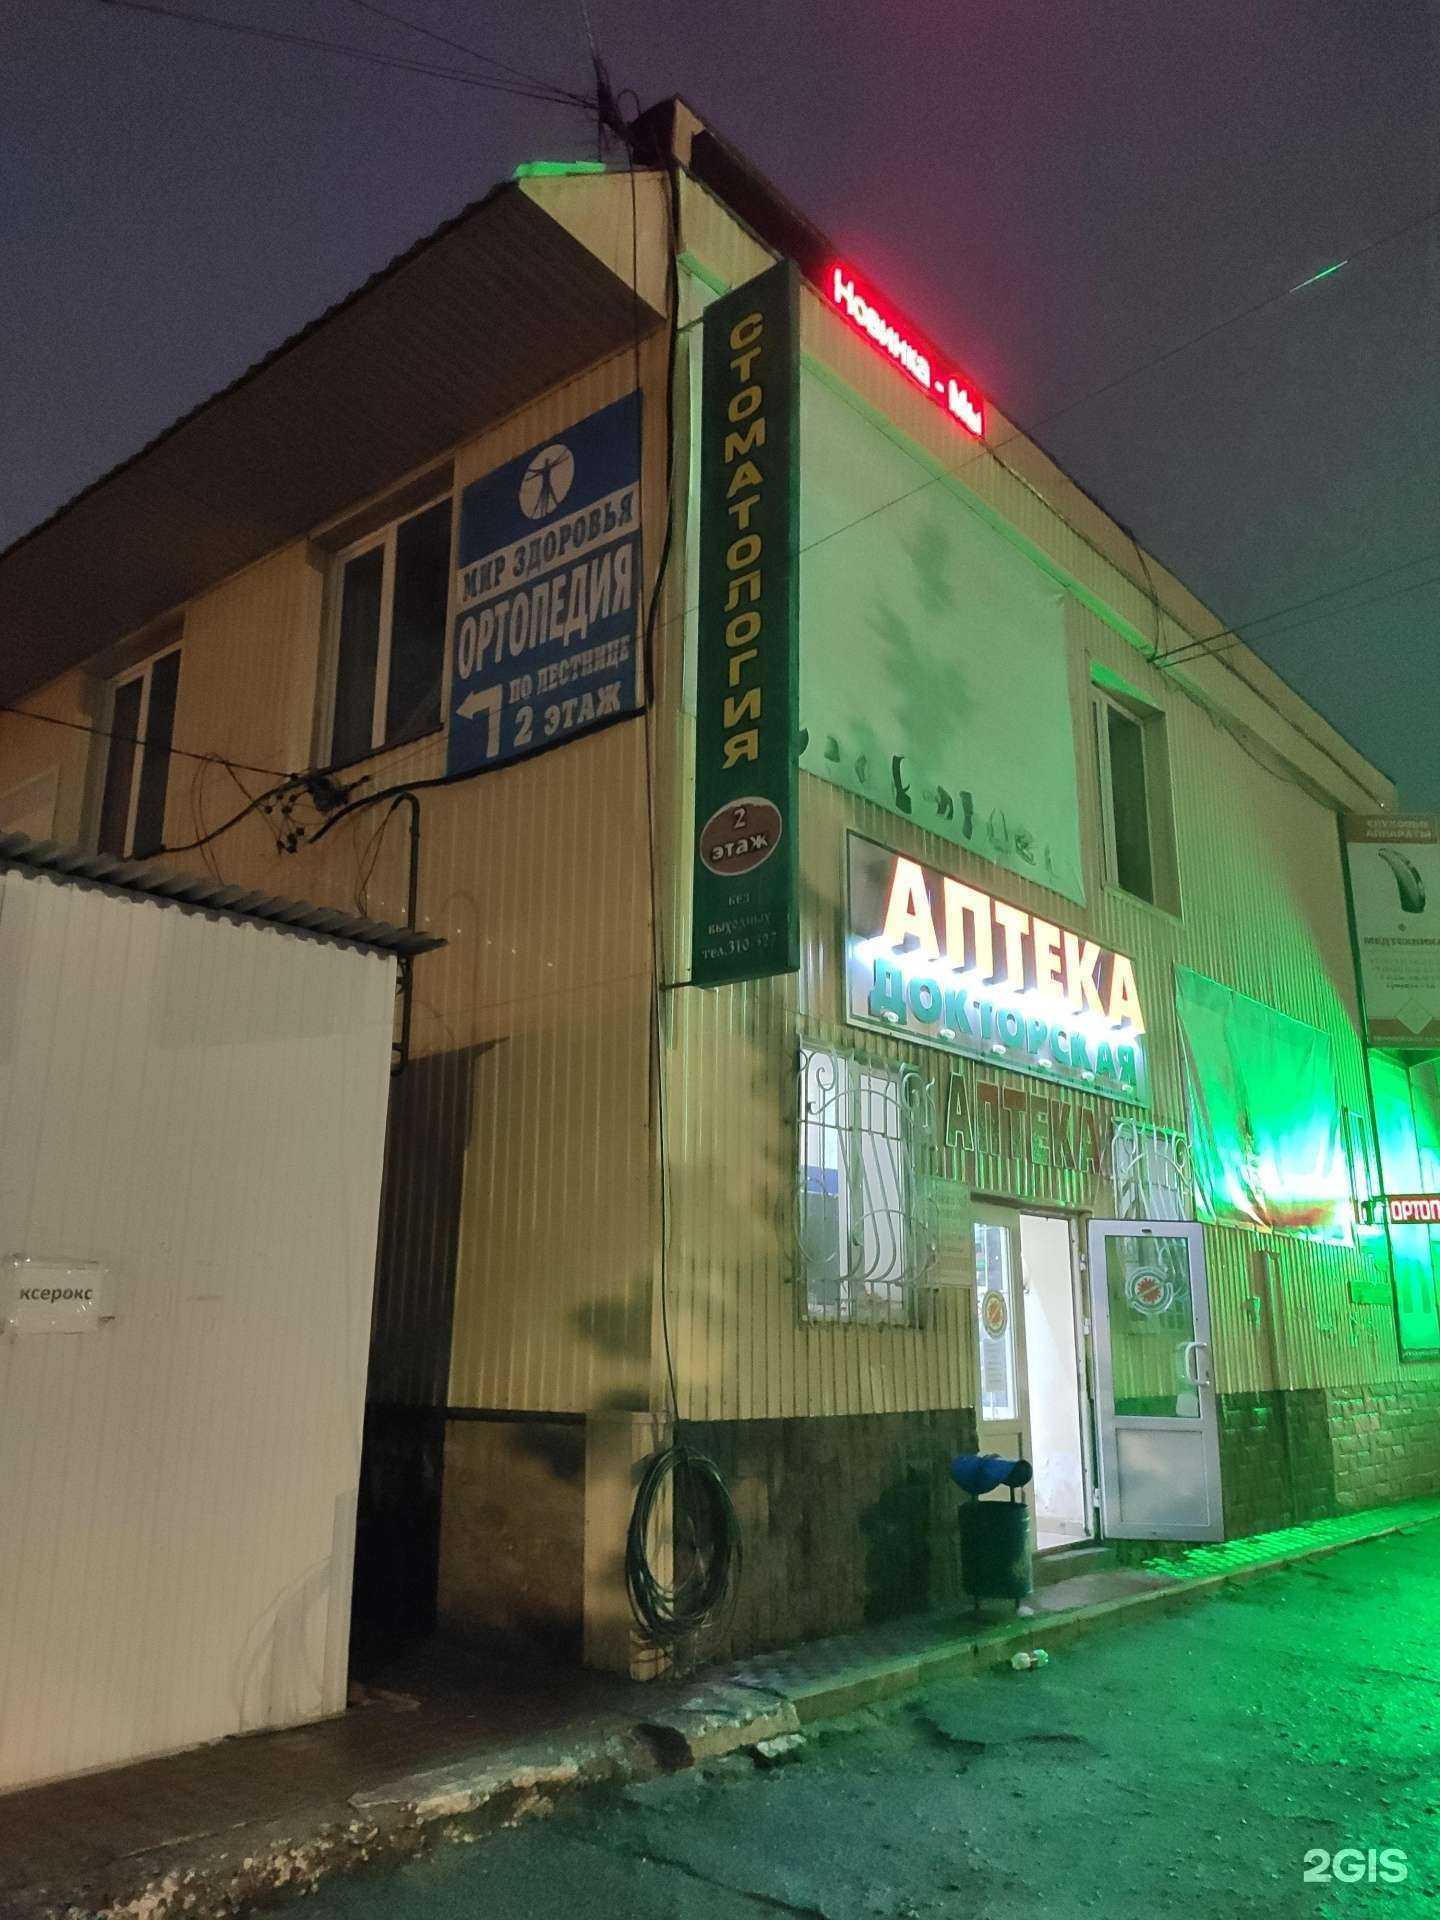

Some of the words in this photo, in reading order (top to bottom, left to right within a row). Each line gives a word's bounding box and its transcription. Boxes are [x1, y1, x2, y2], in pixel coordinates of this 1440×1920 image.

[464, 556, 506, 600] МИР
[512, 491, 634, 577] ЗДОРОВЬЯ
[722, 312, 766, 769] СТОМАТОЛОГИЯ
[457, 544, 632, 680] ОРТОПЕДИЯ
[509, 674, 533, 704] ПО
[536, 635, 631, 695] ЛЕСТНИЦЕ
[513, 706, 534, 747] 2
[543, 681, 621, 736] ЭТАЖ
[734, 808, 747, 829] 2
[881, 853, 1146, 1035] АПТЕКА
[867, 957, 1136, 1082] ДОКТОРСКАЯ
[945, 1071, 1102, 1174] АПТЕКА
[20, 1287, 94, 1303] ксерокс
